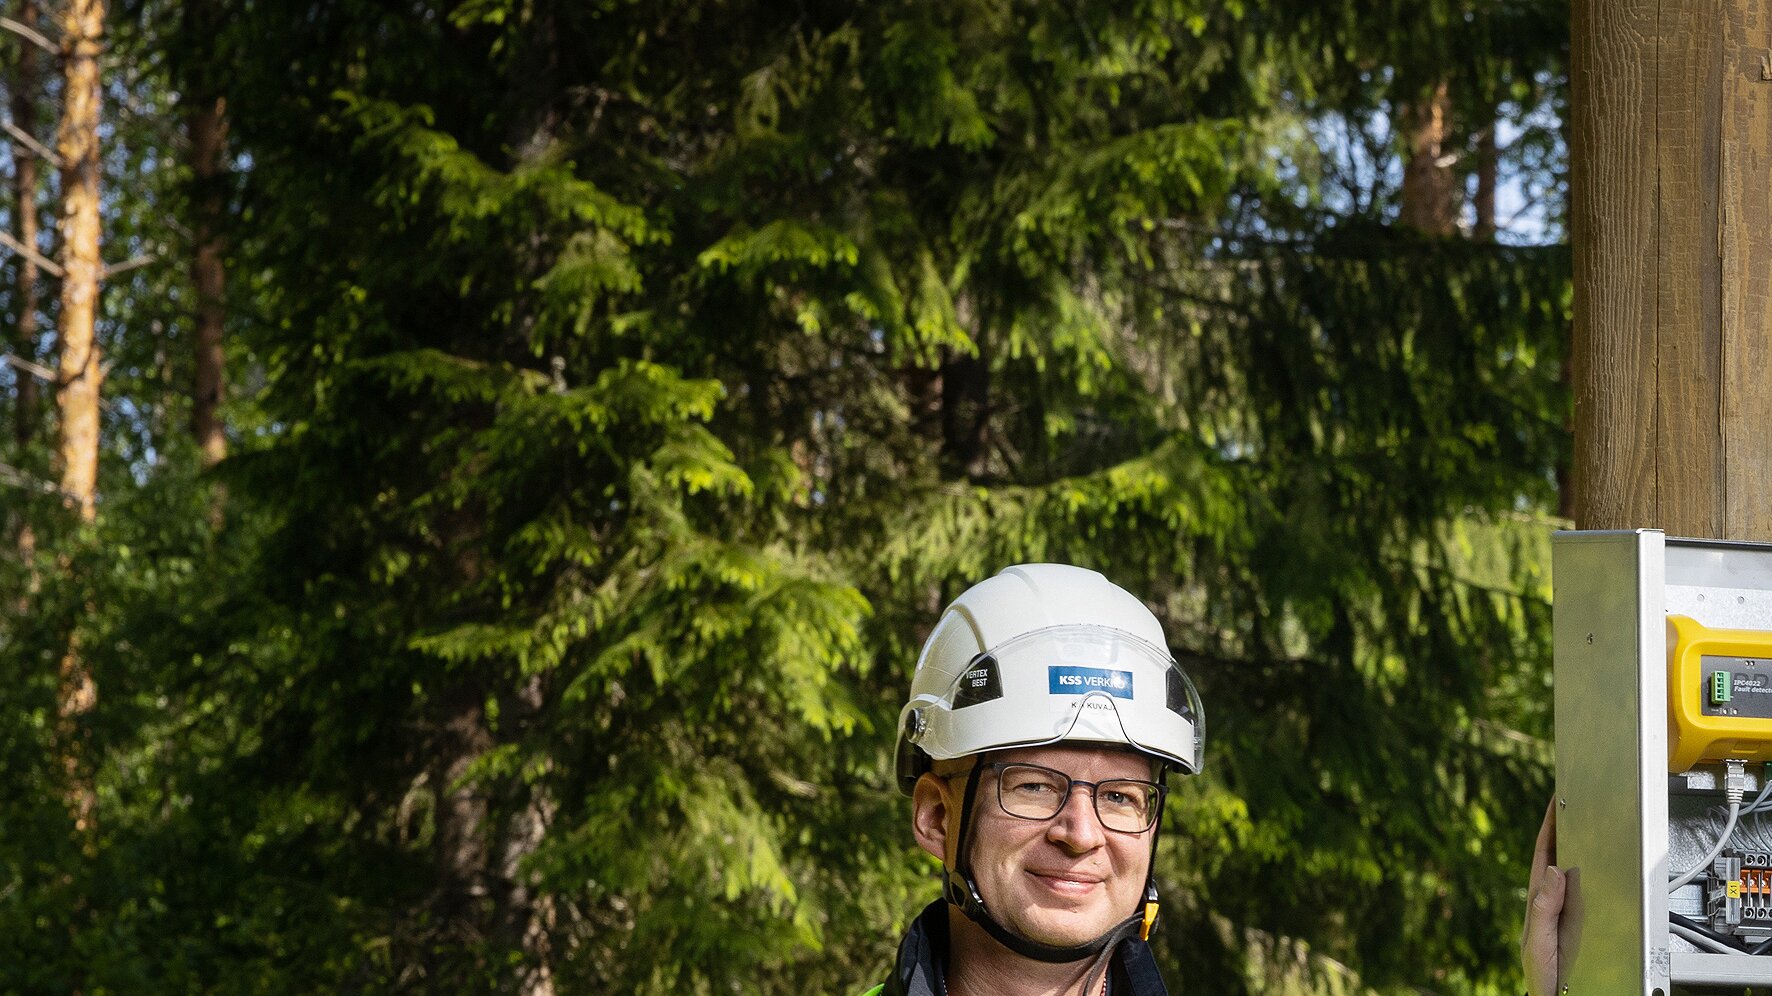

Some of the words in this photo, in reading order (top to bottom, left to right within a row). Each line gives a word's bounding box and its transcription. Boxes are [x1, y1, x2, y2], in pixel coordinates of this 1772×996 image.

[966, 669, 988, 679] VERTEX
[972, 678, 988, 688] BEST
[1060, 676, 1082, 685] KSS
[1730, 885, 1737, 895] X1
